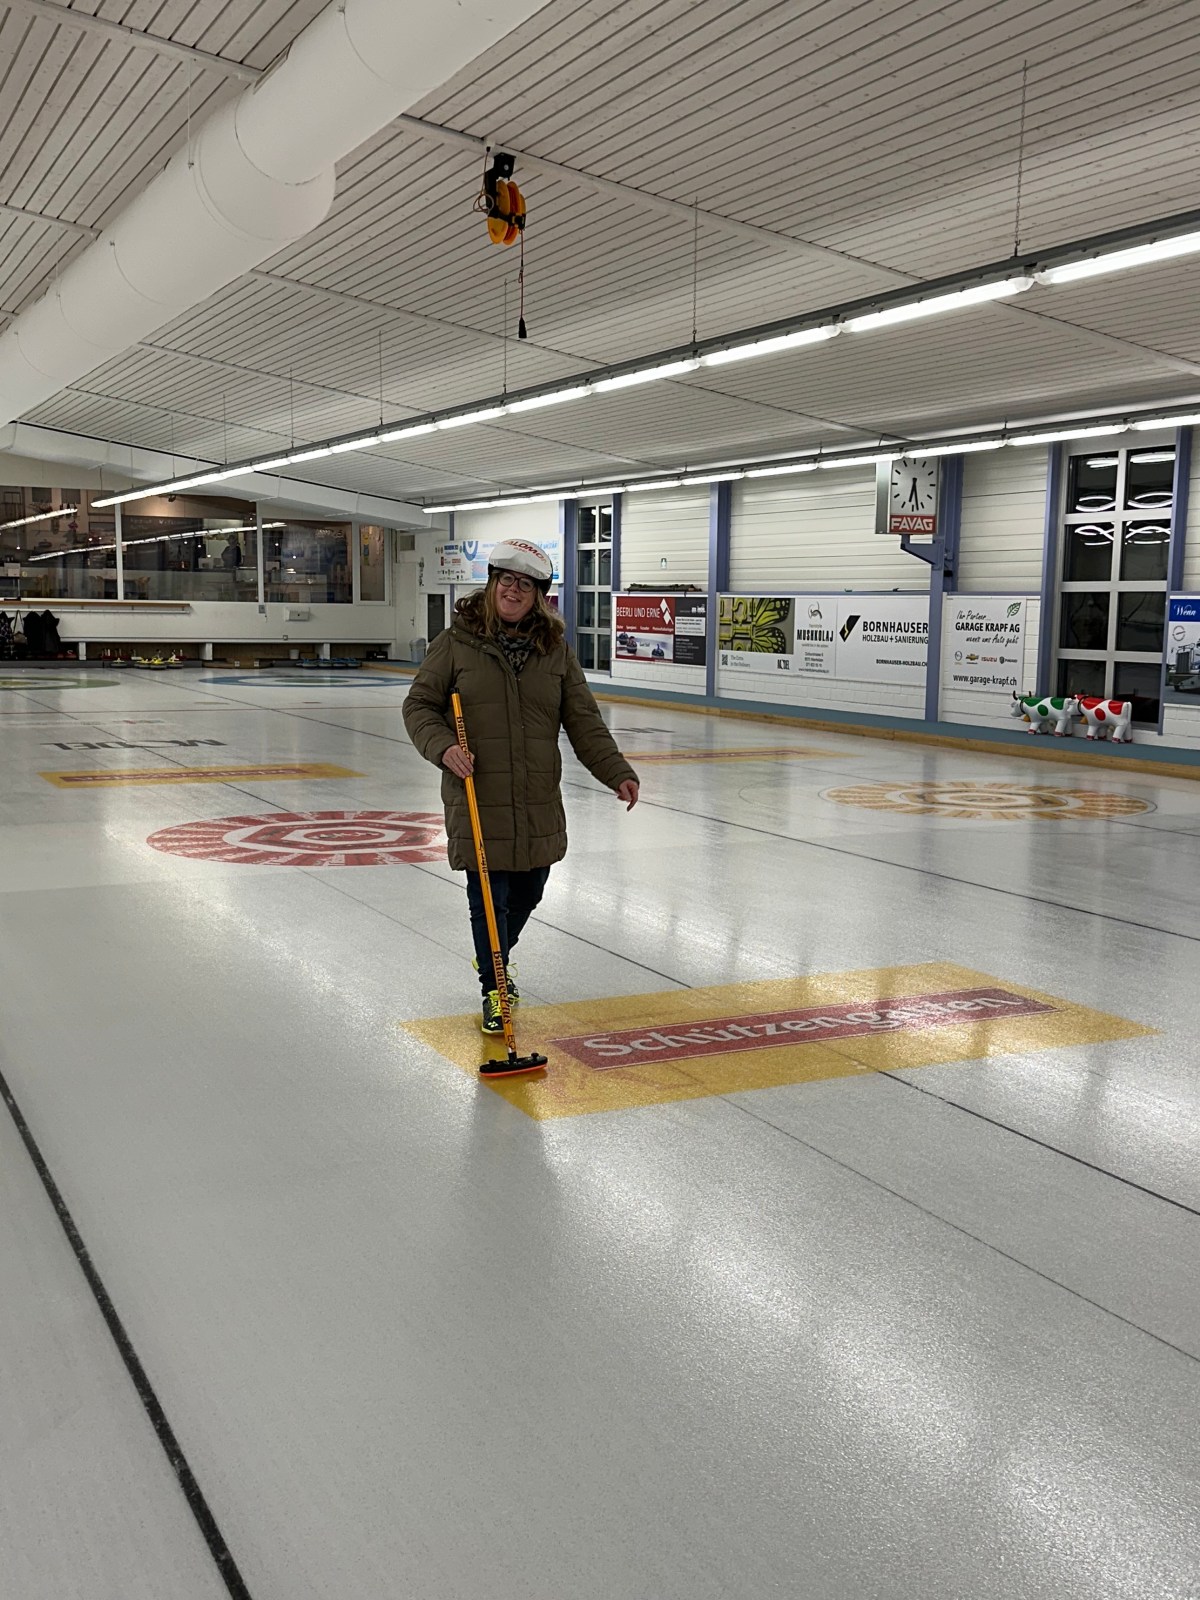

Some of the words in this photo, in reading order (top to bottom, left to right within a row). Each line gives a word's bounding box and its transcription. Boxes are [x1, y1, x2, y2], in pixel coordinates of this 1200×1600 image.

[891, 516, 933, 531] FAVAG
[634, 607, 646, 618] UND
[647, 607, 660, 618] ERNE
[956, 610, 965, 619] Ihr
[863, 621, 929, 634] BORNHAUSER
[955, 622, 984, 632] GARAGE
[985, 623, 1008, 632] KRAPF
[1009, 623, 1020, 633] AG
[862, 635, 889, 643] HOLZBAU
[894, 635, 929, 645] SANIERUNG
[992, 633, 1005, 644] Auto
[1004, 635, 1019, 647] geht
[953, 674, 1017, 687] www.garage-krapf.ch
